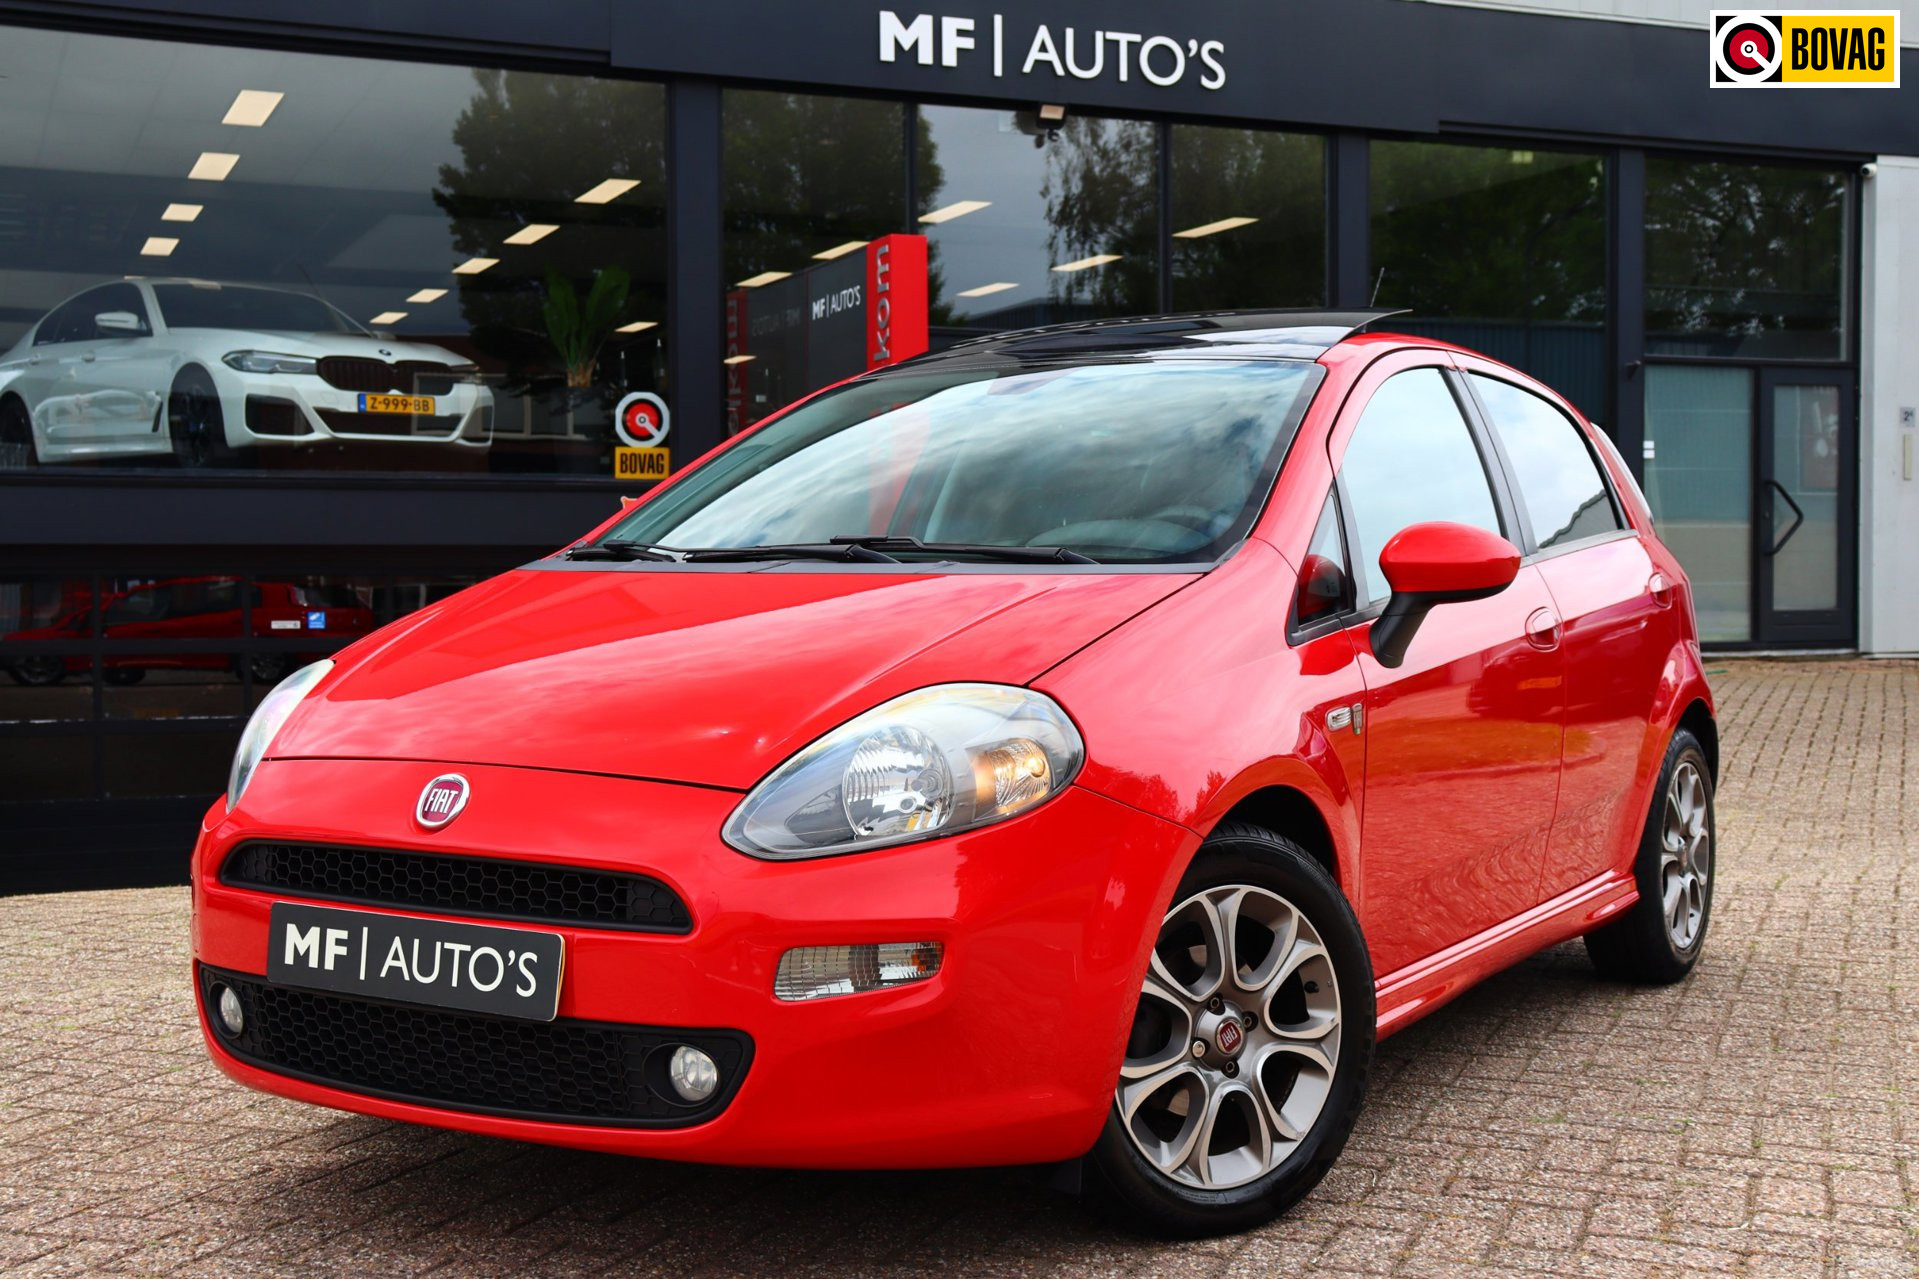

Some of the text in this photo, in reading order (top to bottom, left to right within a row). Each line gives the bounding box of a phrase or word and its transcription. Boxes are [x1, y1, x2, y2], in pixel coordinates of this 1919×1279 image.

[879, 10, 1226, 90] MF AUTO'S
[812, 298, 826, 320] MF
[370, 397, 430, 412] Z-999-BB
[620, 453, 665, 474] BOVAG
[424, 788, 459, 814] FIAT
[284, 923, 538, 998] MF AUTO'S
[1221, 1025, 1238, 1048] FIAT
